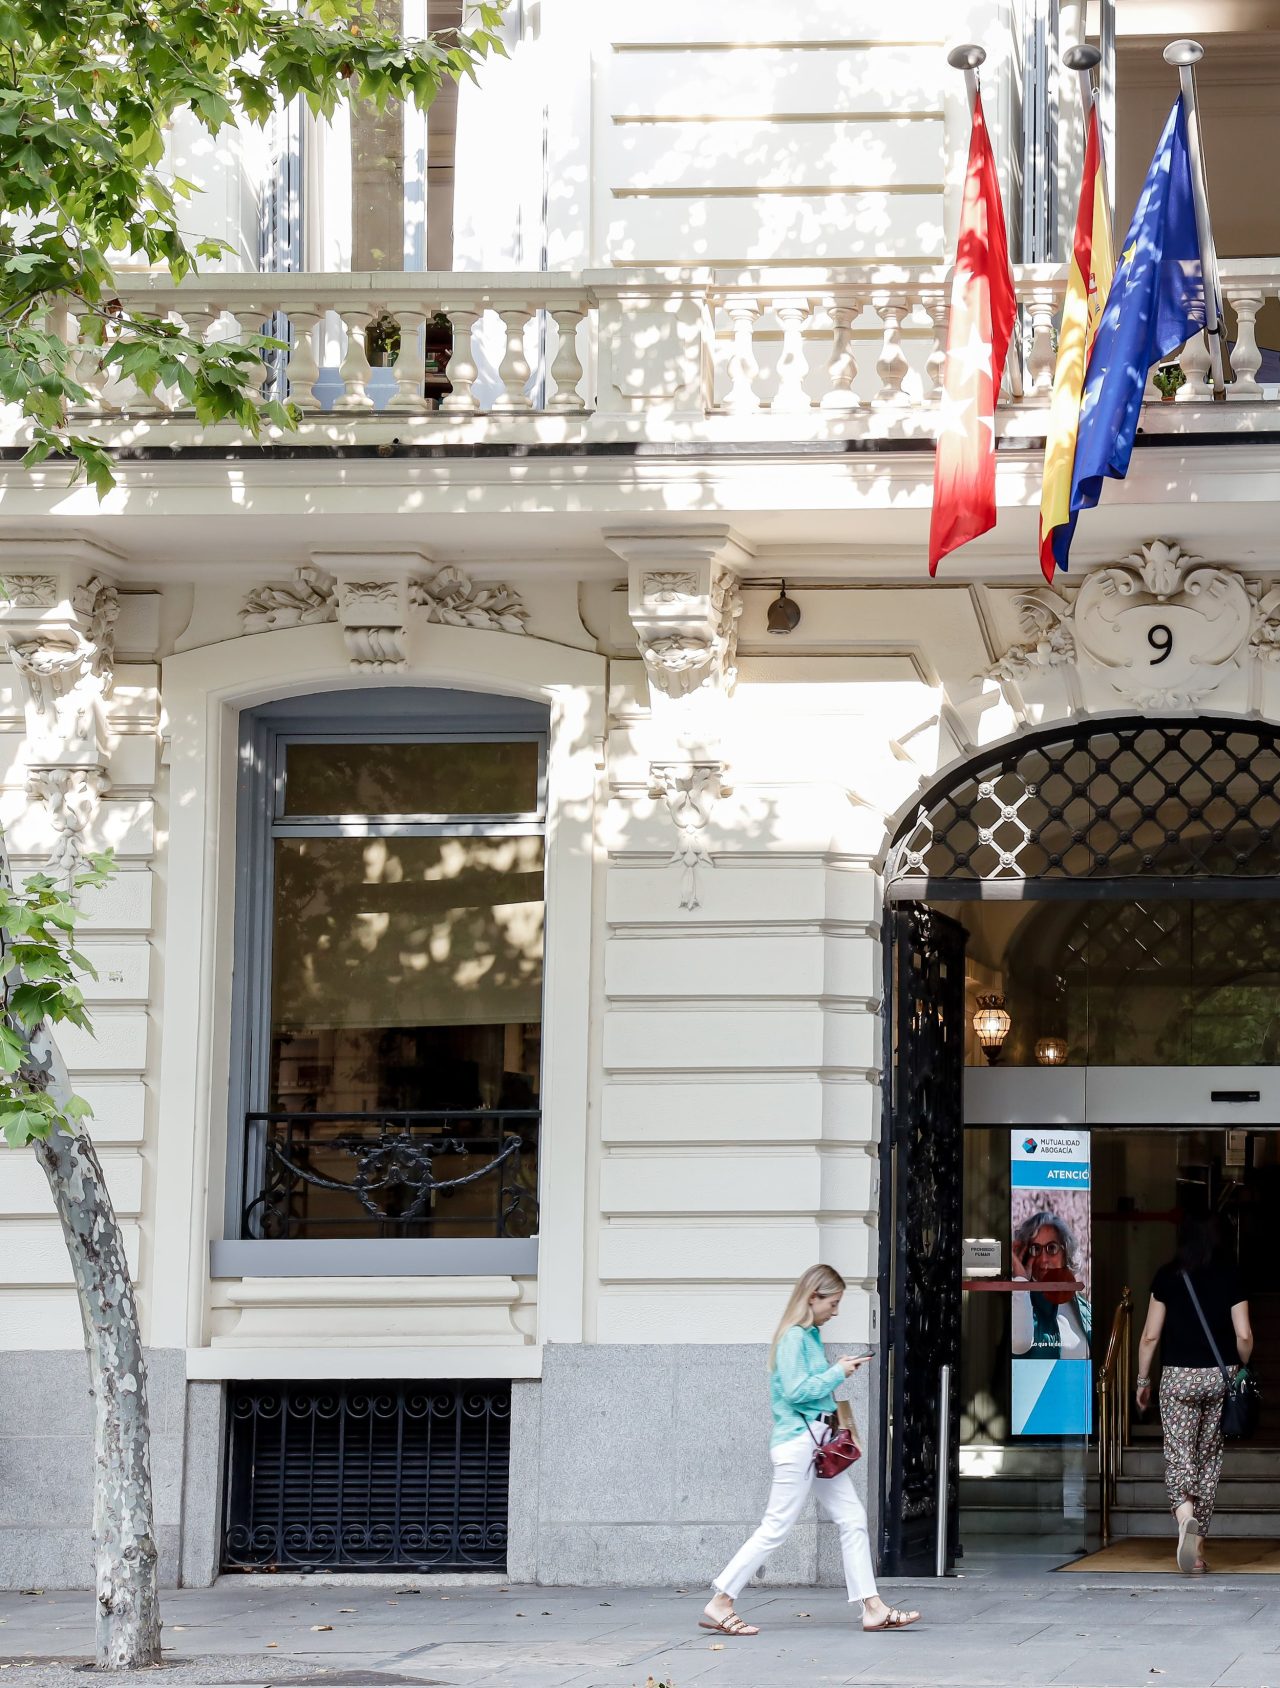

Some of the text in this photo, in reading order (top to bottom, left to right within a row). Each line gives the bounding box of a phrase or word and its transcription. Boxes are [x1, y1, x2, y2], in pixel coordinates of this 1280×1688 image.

[1147, 624, 1173, 665] 9
[1040, 1138, 1080, 1146] MUTUALIDAD
[1040, 1146, 1073, 1154] ABOGACÍA
